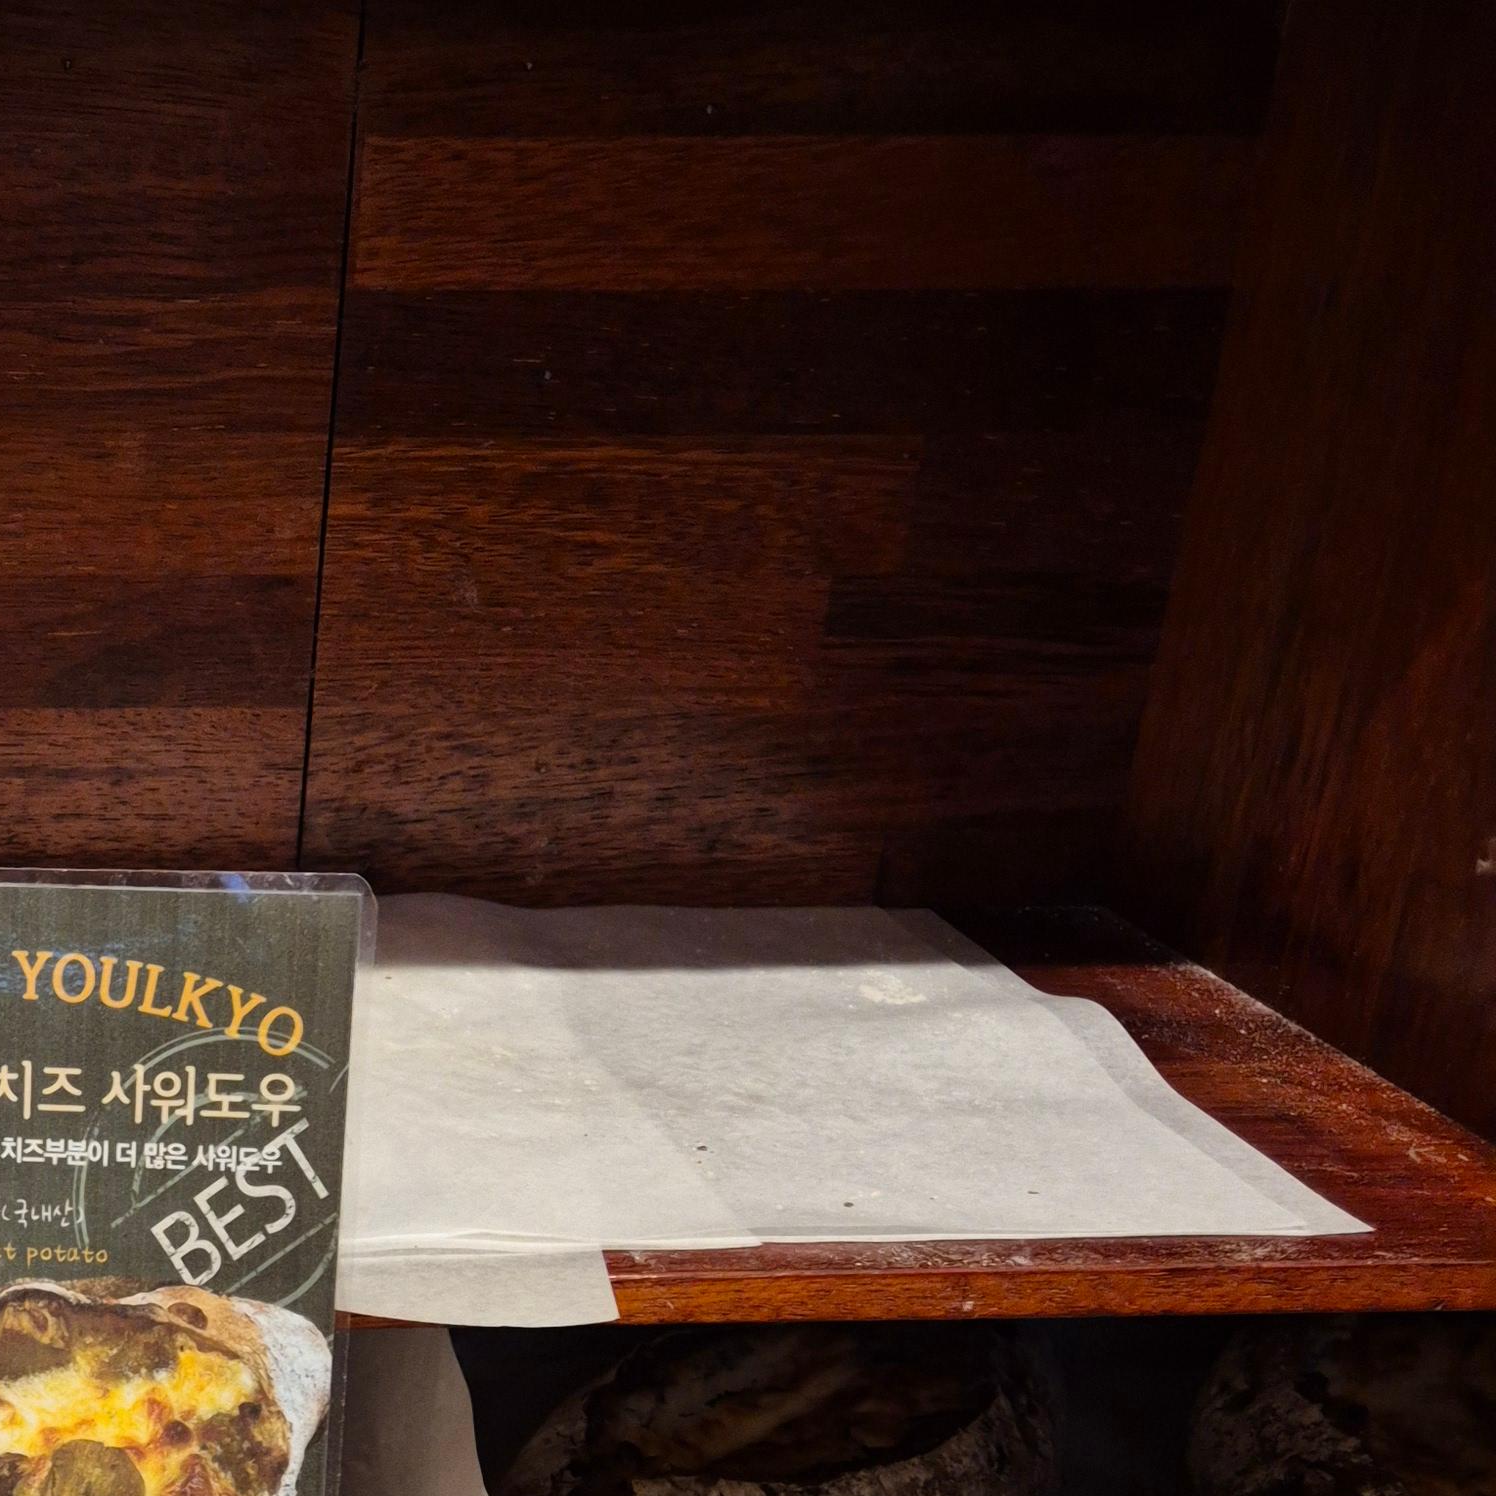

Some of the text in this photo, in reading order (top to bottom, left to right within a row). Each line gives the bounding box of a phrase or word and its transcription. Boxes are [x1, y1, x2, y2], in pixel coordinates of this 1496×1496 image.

[12, 950, 305, 1057] YOULKYO
[102, 1063, 303, 1127] 사워도우
[1, 1137, 109, 1168] 치즈부분이
[116, 1141, 137, 1168] 더
[144, 1142, 189, 1170] 많은
[192, 1144, 283, 1174] 사워도우
[150, 1117, 330, 1286] BEST
[26, 1243, 109, 1270] potato
